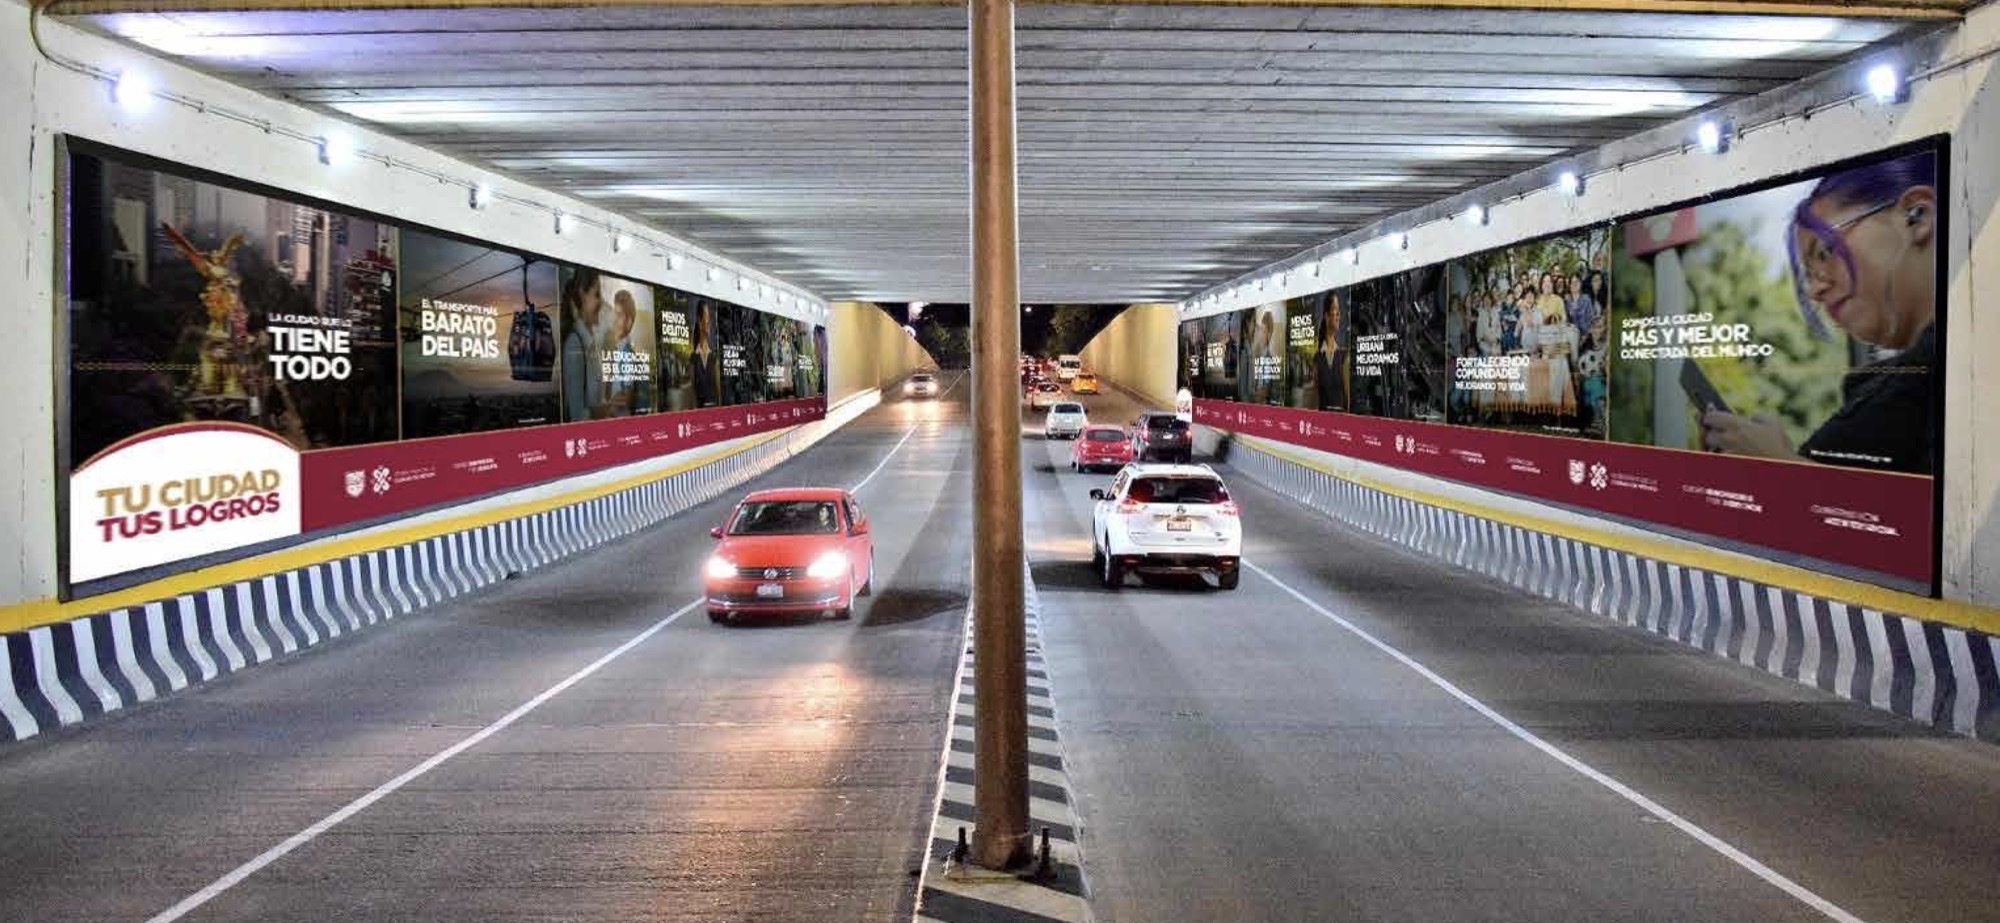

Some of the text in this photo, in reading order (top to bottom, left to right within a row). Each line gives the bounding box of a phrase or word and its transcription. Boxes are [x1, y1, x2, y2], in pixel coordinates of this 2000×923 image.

[422, 310, 497, 337] BARATO
[662, 310, 686, 325] MENOS
[1291, 314, 1312, 327] MENOS
[1622, 312, 1714, 329] SOMOS LA CIUDAD
[662, 323, 690, 338] DELITOS
[1661, 328, 1675, 344] Y
[1678, 323, 1750, 345] MEJOR
[268, 326, 350, 354] TIENE
[422, 334, 500, 359] DEL PAÍS
[1356, 352, 1399, 364] MEJORAMOS
[1620, 344, 1775, 360] CONECTADA DEL MUNDO
[268, 354, 352, 380] TODO
[1456, 354, 1530, 368] FORTALECIENDO
[1455, 368, 1521, 380] COMUNIDADES
[1455, 381, 1496, 390] MEJORANDO
[1497, 382, 1507, 391] TU
[96, 468, 281, 517] TU CIUDAD
[96, 492, 281, 543] TUS LOGROS
